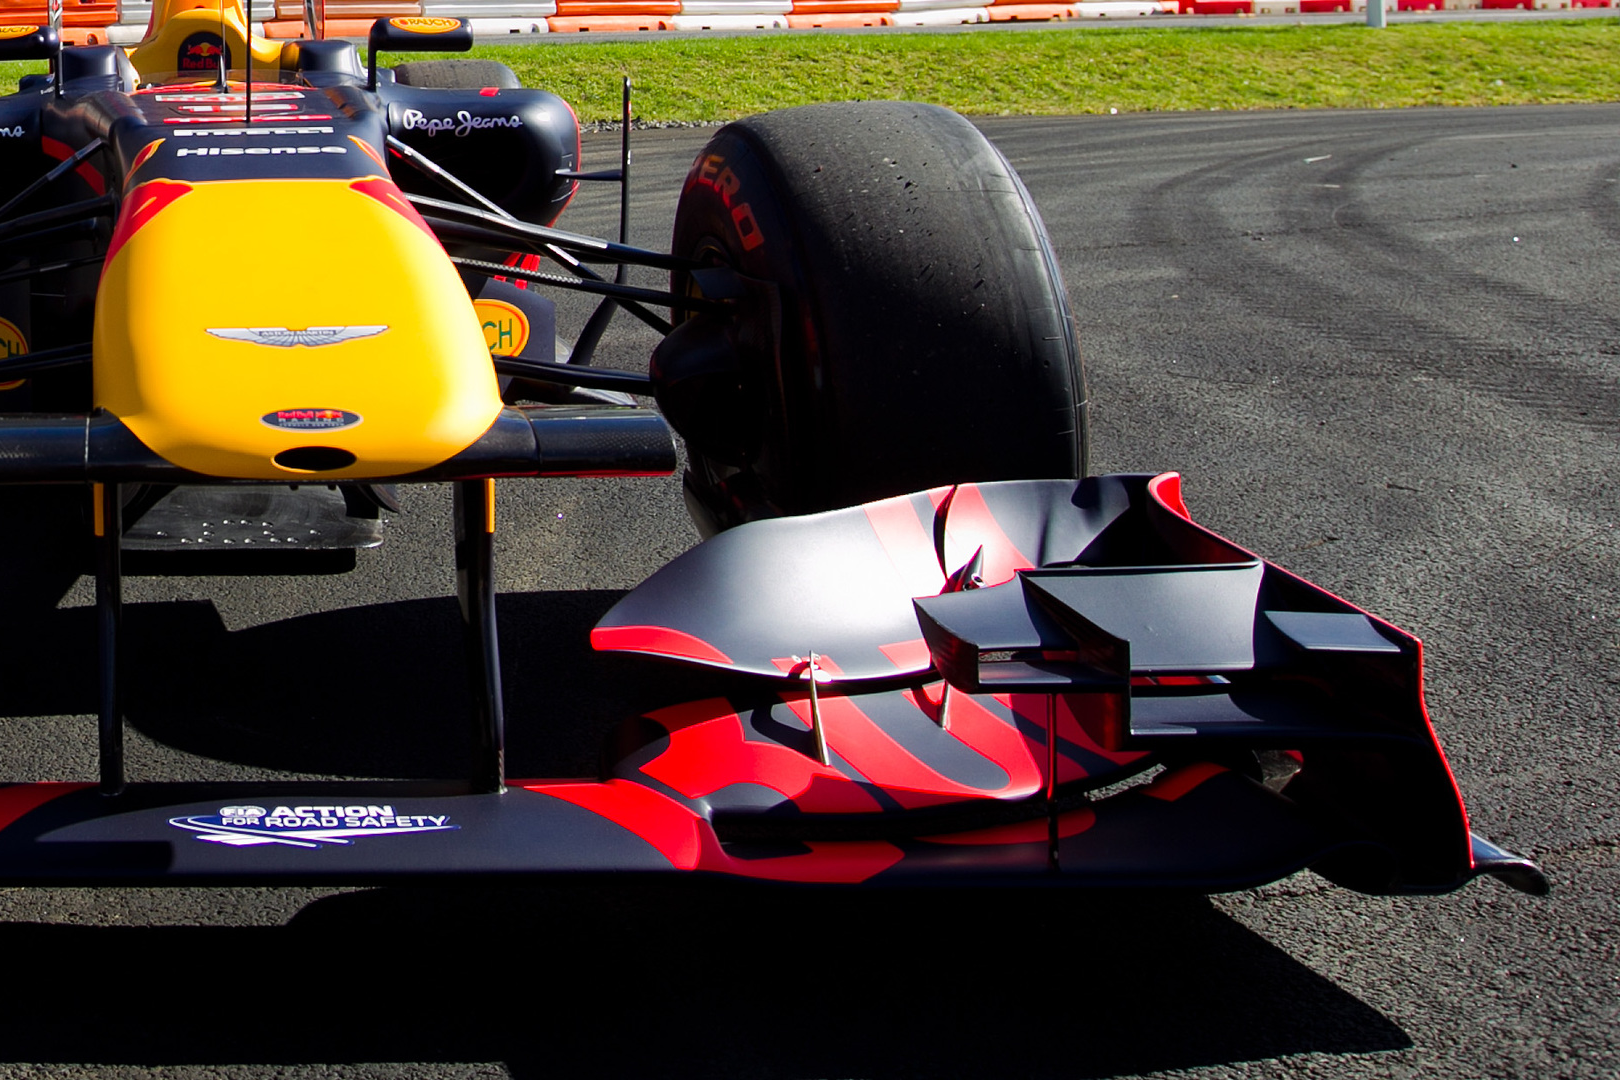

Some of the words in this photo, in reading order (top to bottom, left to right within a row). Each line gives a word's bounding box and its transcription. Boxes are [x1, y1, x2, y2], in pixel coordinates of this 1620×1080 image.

[182, 57, 204, 69] Red
[402, 109, 455, 137] Pepe
[454, 110, 523, 138] Jeans
[221, 807, 265, 817] FIA
[271, 805, 395, 818] ACTION
[221, 816, 260, 826] FOR
[264, 816, 339, 828] ROAD
[345, 815, 447, 828] SAFETY
